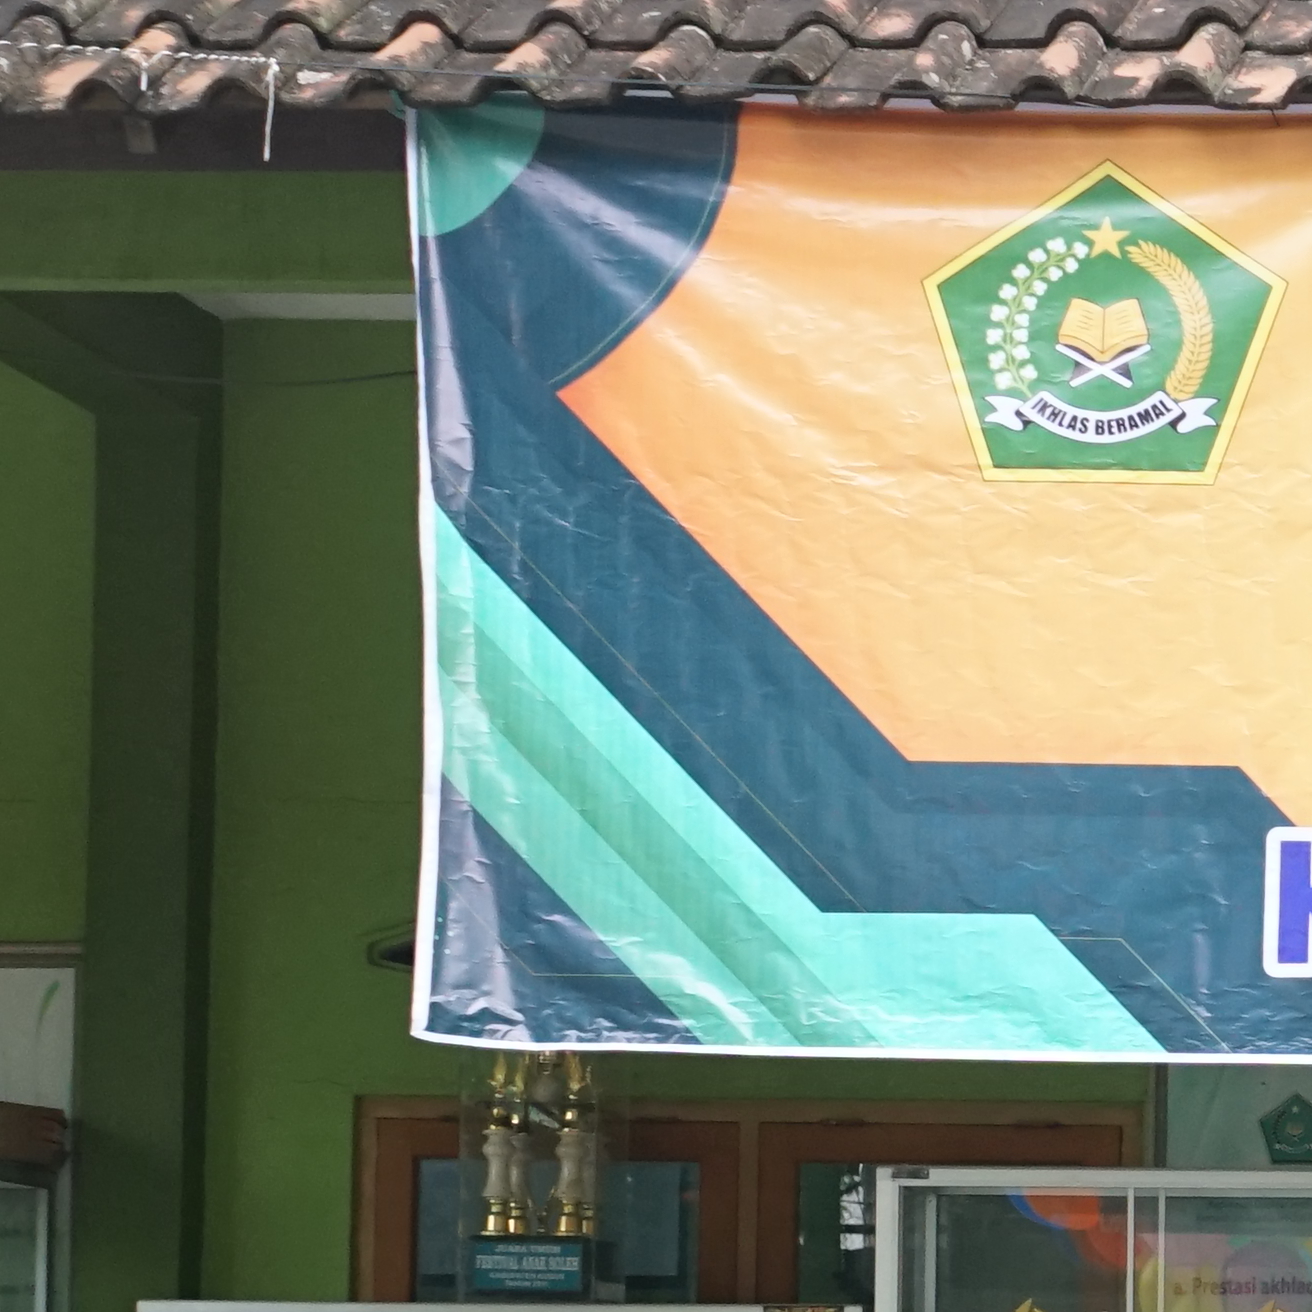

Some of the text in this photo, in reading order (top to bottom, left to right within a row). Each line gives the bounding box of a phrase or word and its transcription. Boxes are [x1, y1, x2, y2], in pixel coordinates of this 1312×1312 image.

[1030, 396, 1174, 437] IKHLAS BERAMAL
[1193, 1276, 1257, 1295] Prestasi
